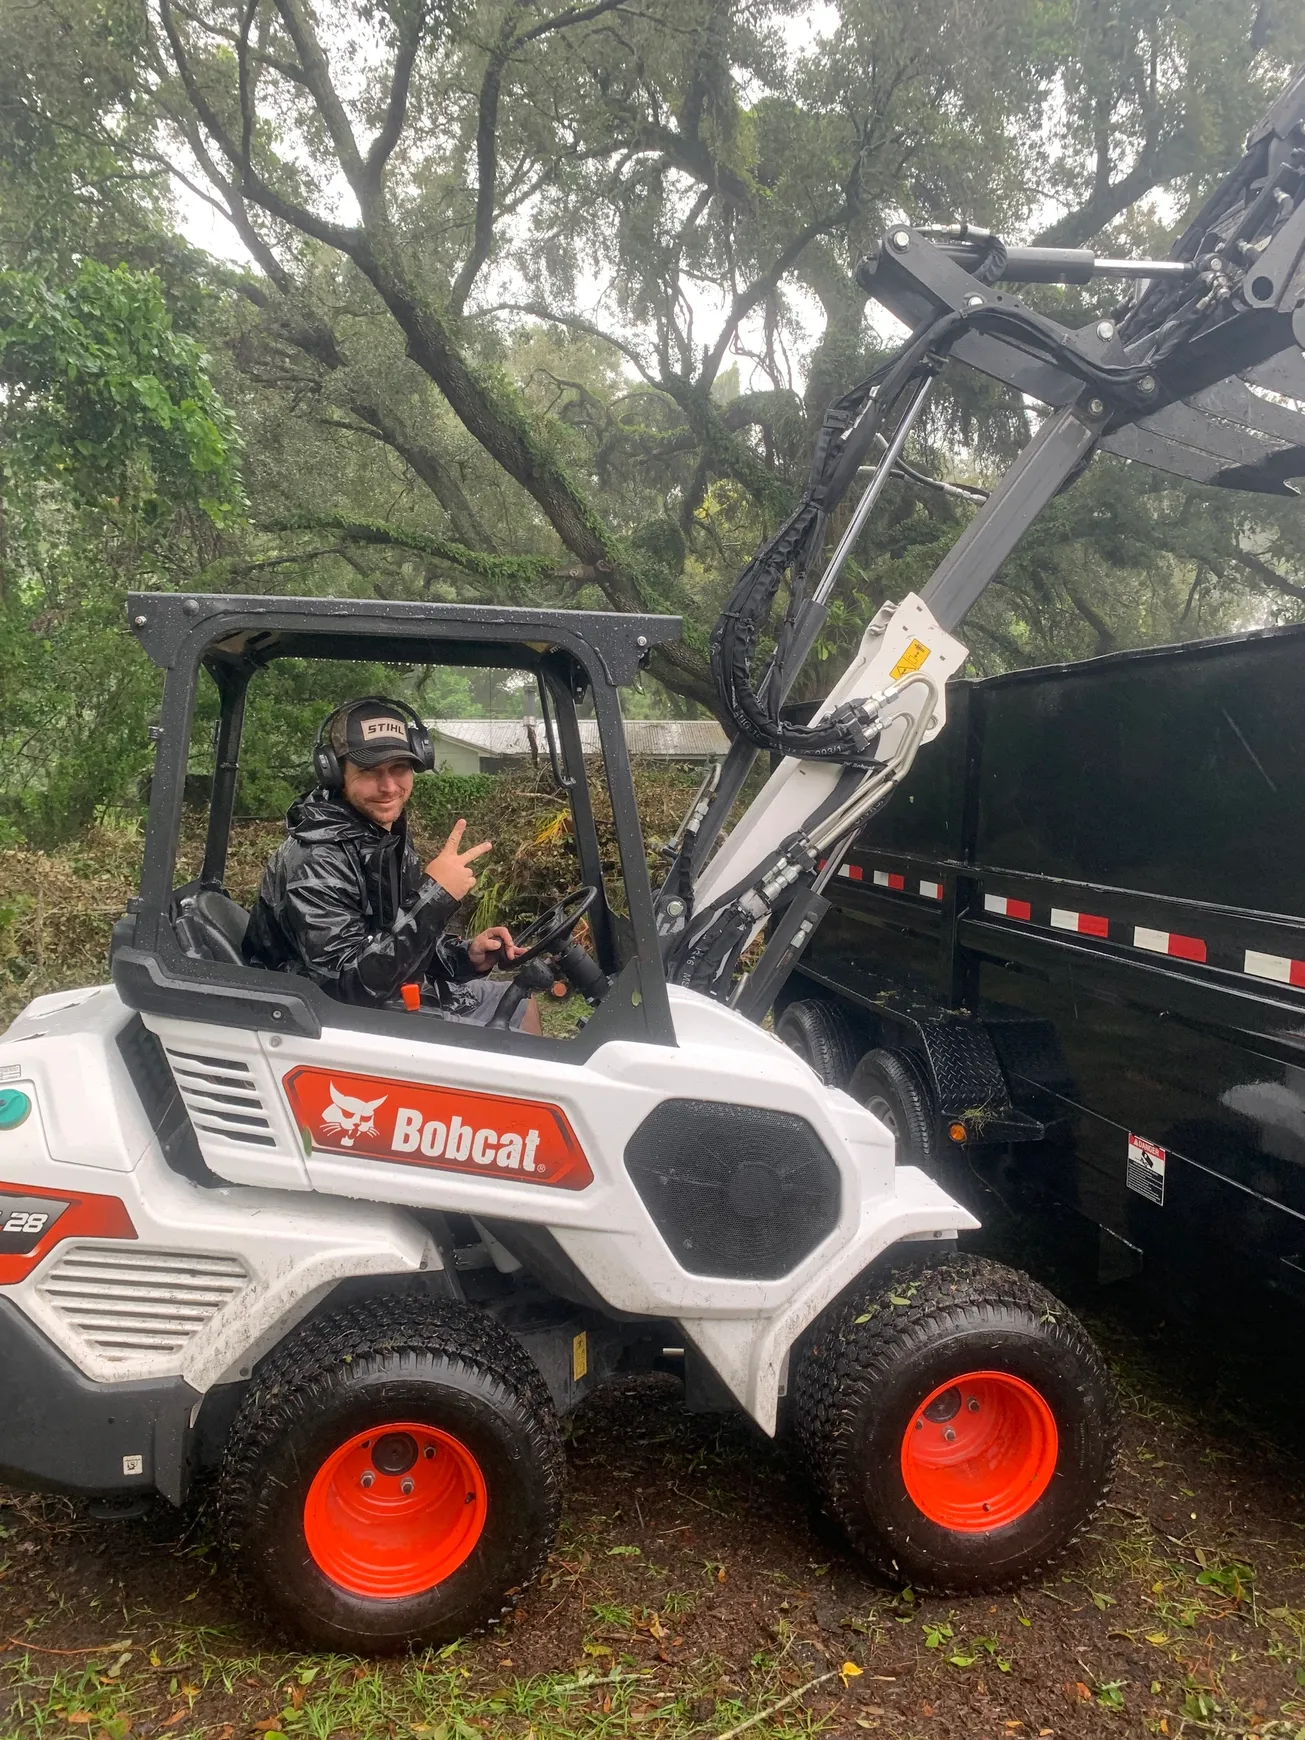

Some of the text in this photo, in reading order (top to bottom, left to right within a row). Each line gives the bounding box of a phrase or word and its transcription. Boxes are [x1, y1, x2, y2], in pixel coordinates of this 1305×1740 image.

[368, 723, 404, 735] STIHL
[391, 1107, 541, 1172] Bobcat
[1138, 1141, 1160, 1156] DANGER
[0, 1211, 49, 1233] 28
